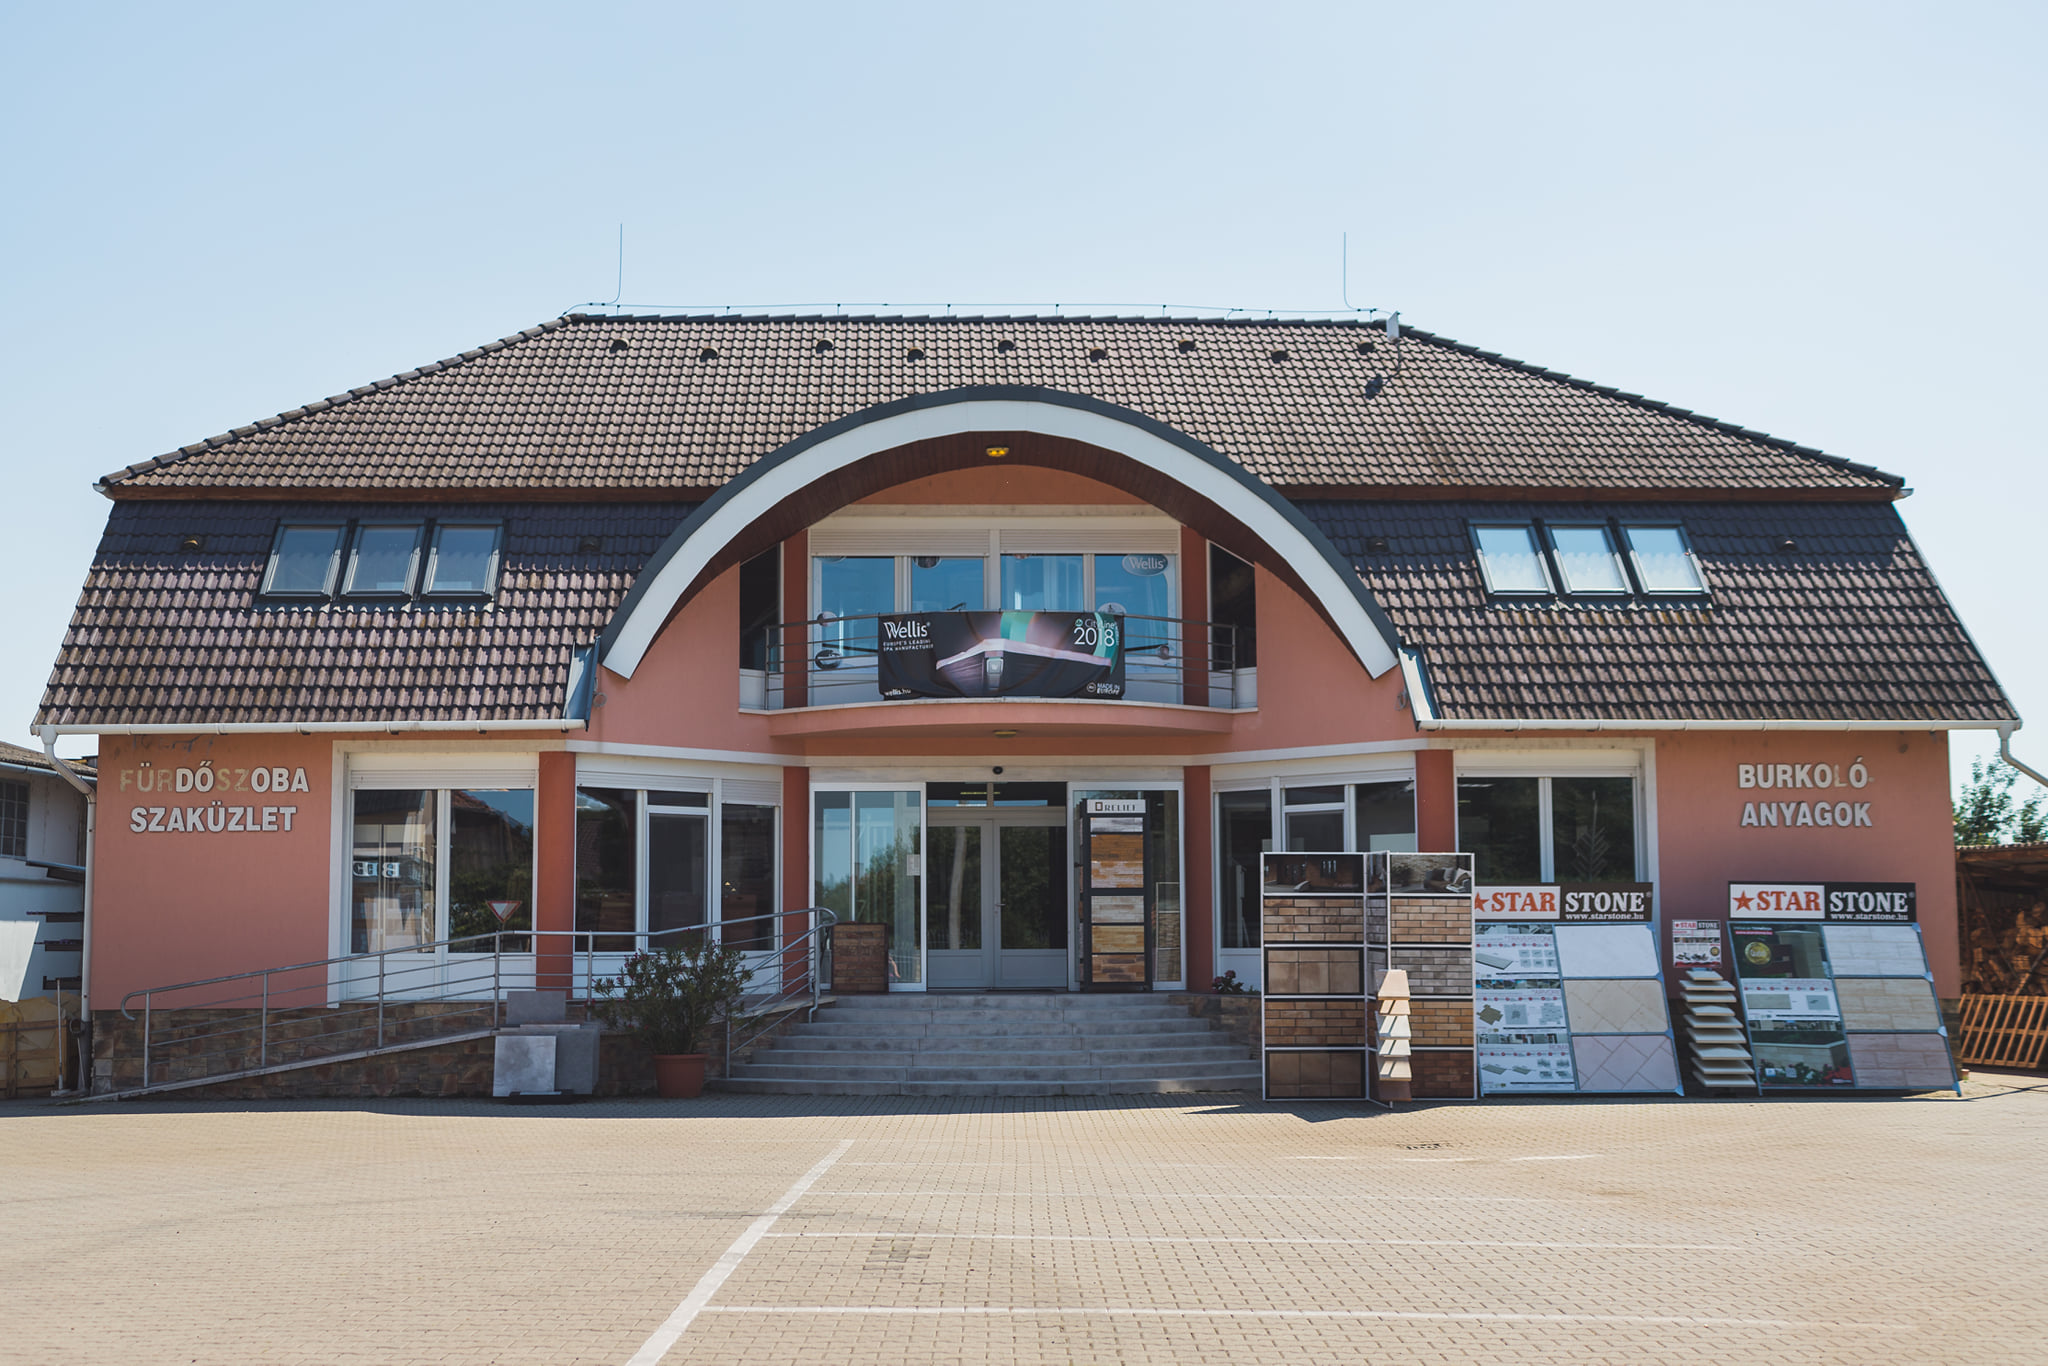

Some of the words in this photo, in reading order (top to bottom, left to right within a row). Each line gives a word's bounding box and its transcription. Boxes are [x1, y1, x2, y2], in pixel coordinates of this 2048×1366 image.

[1129, 557, 1165, 570] Wellis
[883, 620, 929, 639] Wellis
[1074, 627, 1115, 647] 2018
[120, 760, 310, 793] FÜRDŐSZOBA
[130, 801, 297, 832] SZAKÜZLET
[1740, 801, 1873, 827] ANYAGOK
[1491, 892, 1556, 912] STAR
[1565, 892, 1645, 913] STONE
[1757, 890, 1821, 911] STAR
[1830, 891, 1908, 913] STONE
[1830, 913, 1908, 921] www.starstone.hu
